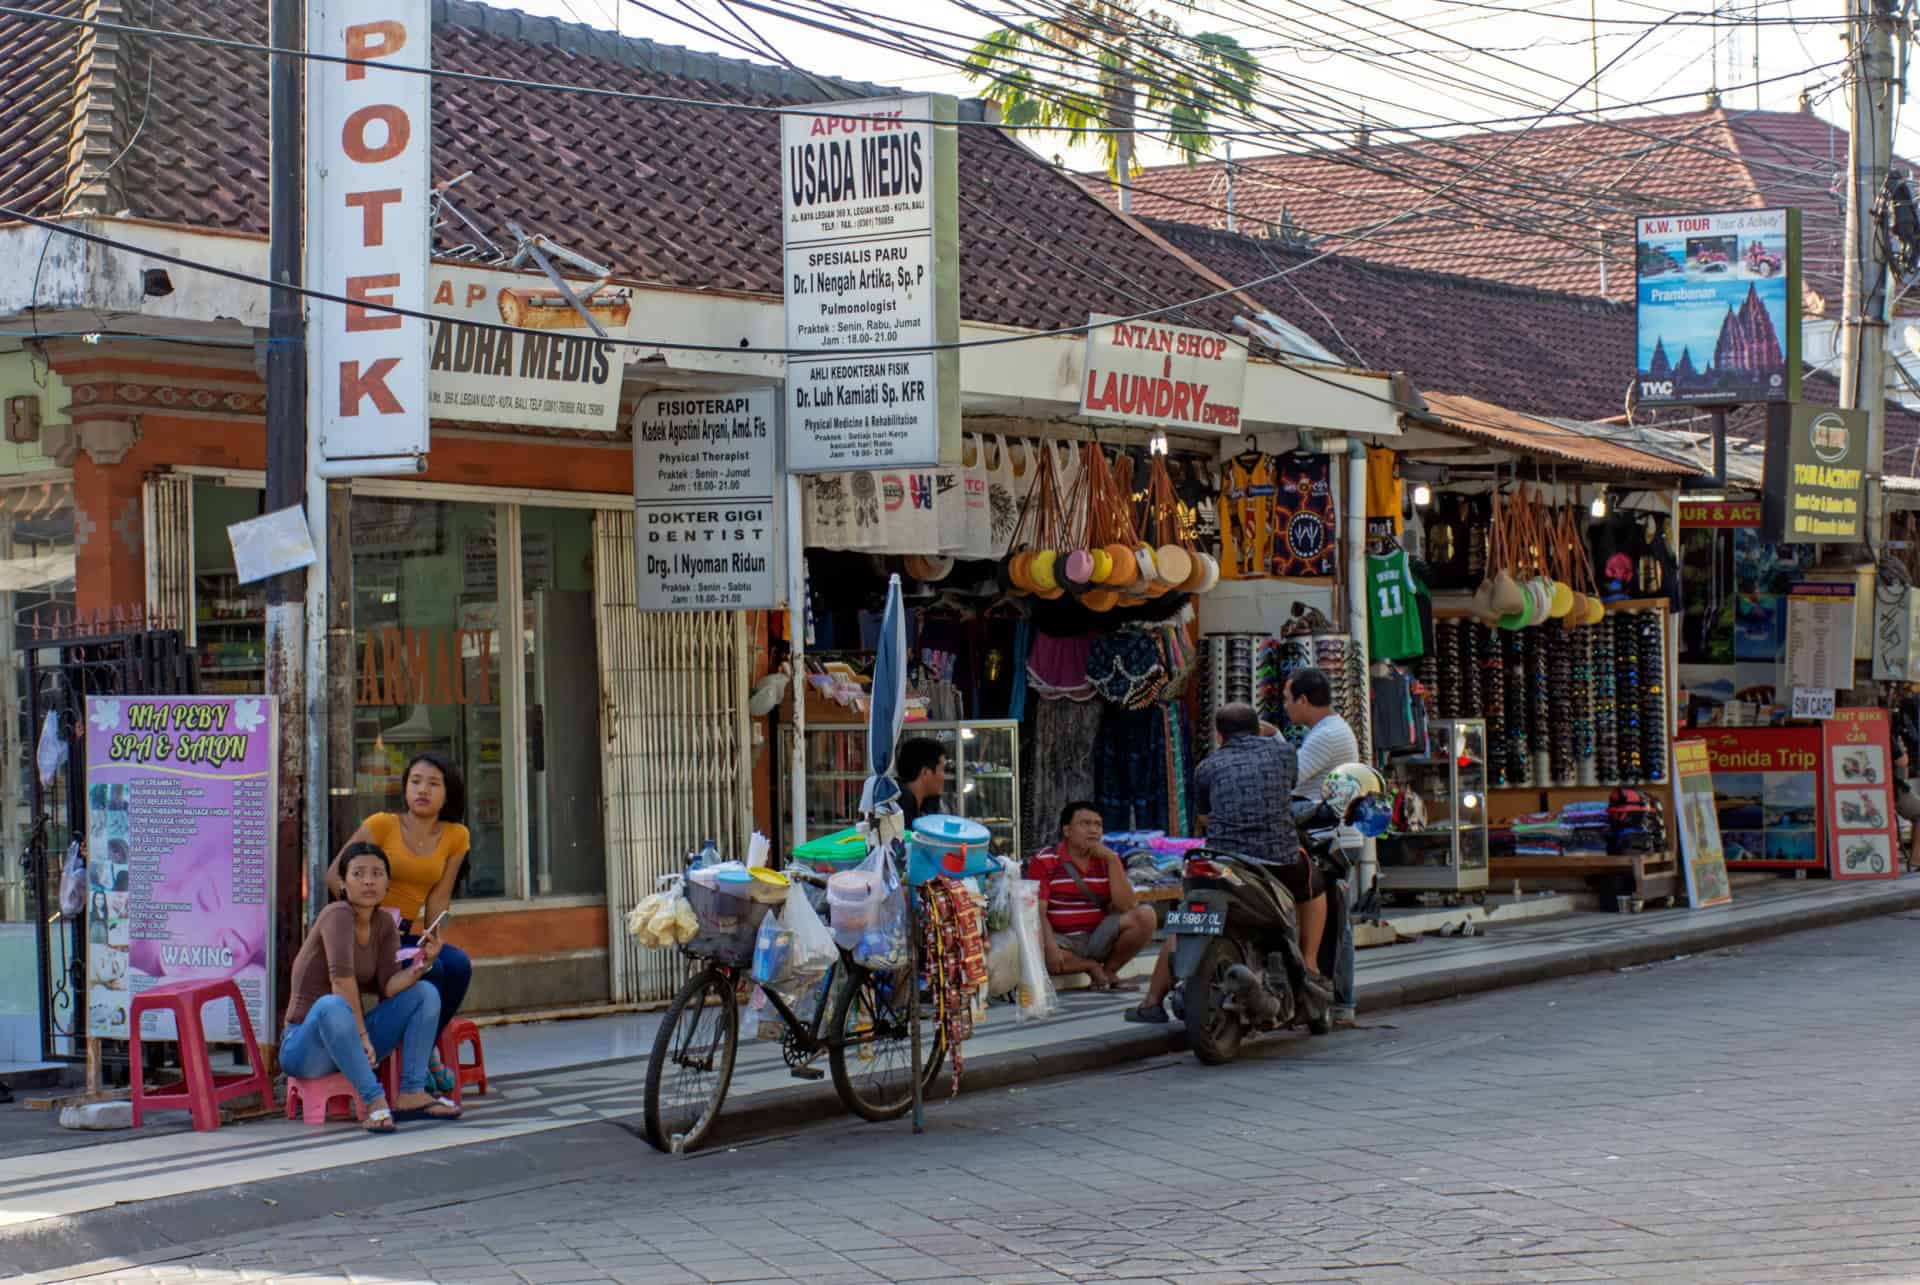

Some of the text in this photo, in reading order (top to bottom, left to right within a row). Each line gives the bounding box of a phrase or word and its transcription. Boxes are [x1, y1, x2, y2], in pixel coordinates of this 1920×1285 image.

[811, 111, 903, 136] APOTEK
[790, 131, 922, 206] USADA MEDIS
[815, 209, 834, 220] LEGIAN
[853, 206, 874, 216] LEGIAN
[912, 201, 925, 209] BALI
[1645, 222, 1672, 234] K.W.
[1677, 218, 1710, 232] TOUR
[809, 247, 907, 266] SPESIALIS PARU
[794, 265, 923, 296] Dr. I Nengah Artika, Sp. P
[1651, 288, 1715, 302] Prambanan
[821, 299, 896, 316] Pulmonologist
[798, 318, 920, 335] Praktek Senin, Rabu, Jumat
[821, 336, 839, 346] Jam
[875, 331, 897, 342] 21.00
[1112, 323, 1226, 360] INTAN SHOP
[520, 332, 609, 384] MEDIS
[810, 362, 909, 381] AHLI KEDOKTERAN FISIK
[796, 381, 925, 408] Dr. Luh Kamiati Sp. KFR
[1086, 369, 1240, 427] LAUNDRY EXPRESS
[1641, 382, 1672, 397] TWC
[658, 398, 749, 416] FISIOTERAPI
[642, 416, 766, 446] Kadek Agustini Aryani, Amd. Fis
[805, 414, 918, 432] Physical Medicine & Rehabilitation
[659, 451, 749, 464] Physical Therapist
[658, 468, 750, 480] Praktek Senin Jumat
[669, 483, 686, 492] Jam
[648, 510, 762, 524] DOKTER GIGI
[1713, 508, 1724, 520] &
[648, 529, 763, 542] DENTIST
[648, 552, 765, 579] Drg. I Nyoman Ridun
[661, 582, 751, 592] Praktek Senin Sabtu
[1378, 585, 1403, 617] 11
[1795, 697, 1833, 716] SIM CARD
[128, 703, 230, 732] NIA PEBY
[110, 734, 248, 768] SPA & SALON
[1777, 750, 1816, 771] Trip
[1168, 912, 1180, 924] DK
[161, 945, 233, 968] WAXING
